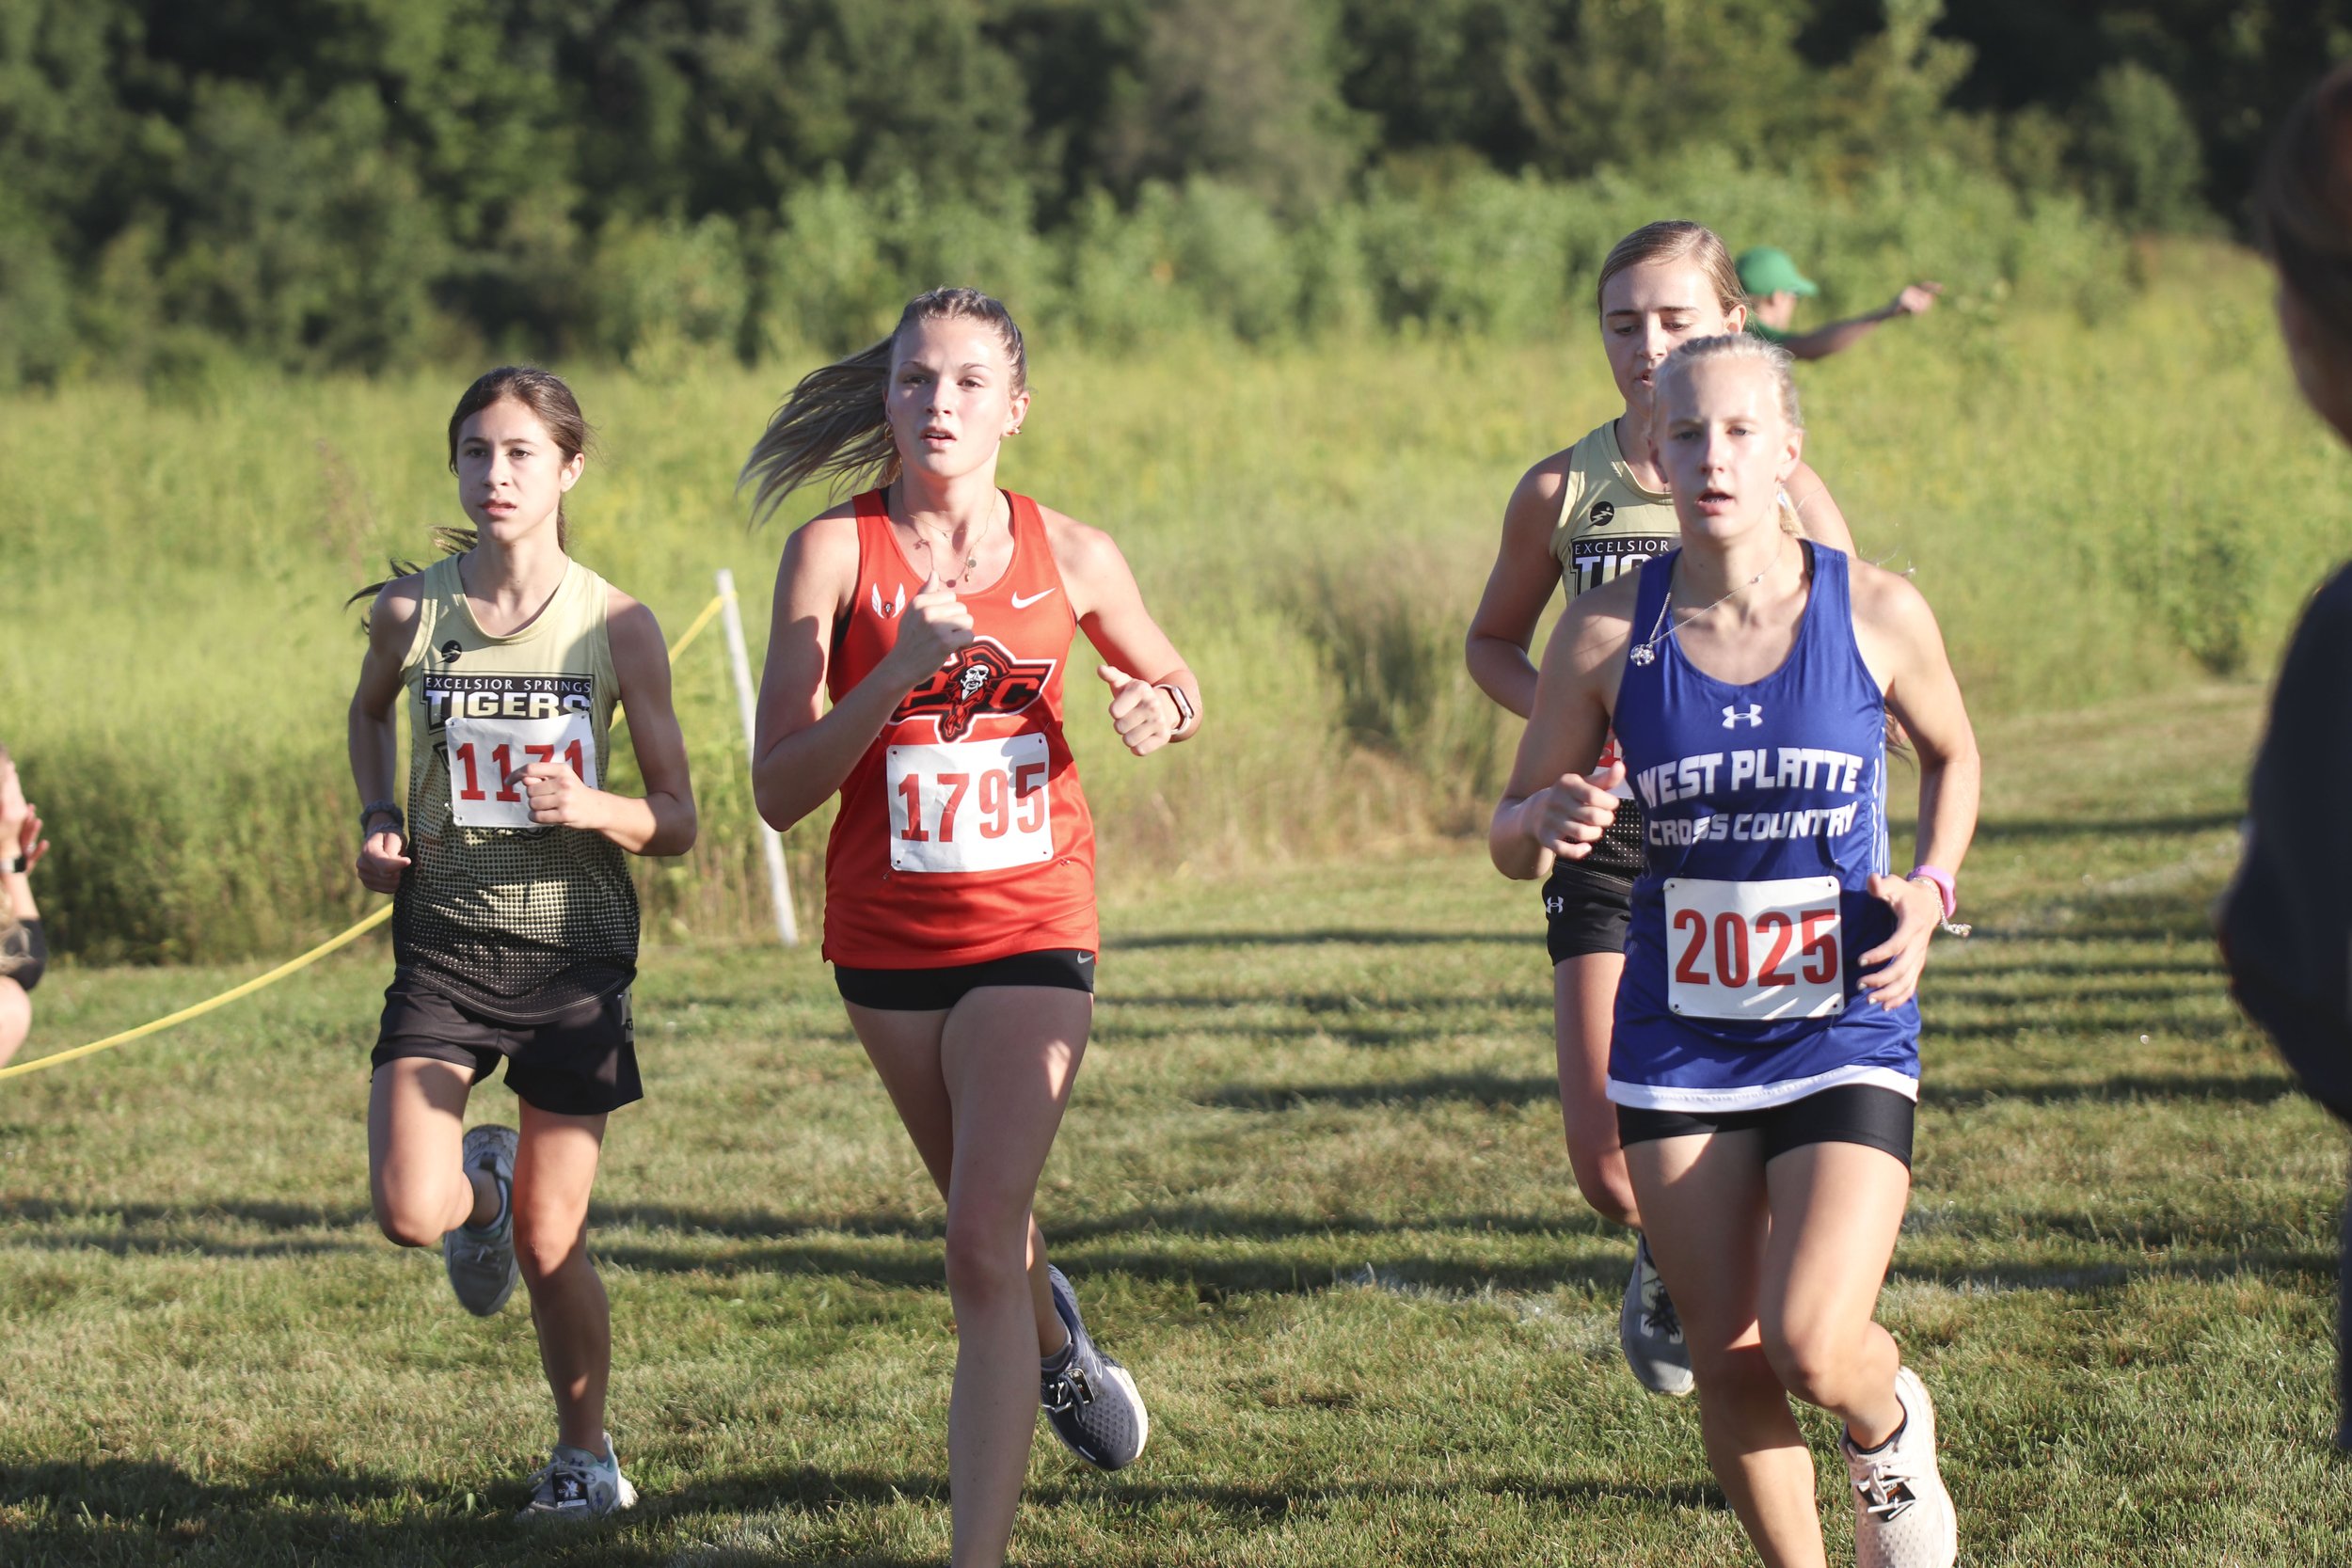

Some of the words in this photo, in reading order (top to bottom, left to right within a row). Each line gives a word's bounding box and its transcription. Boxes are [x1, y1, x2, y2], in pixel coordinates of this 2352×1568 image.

[1575, 540, 1669, 555] EXCELSIOR
[425, 677, 513, 690] EXCELSIOR
[524, 679, 591, 693] SPRINGS
[898, 761, 1046, 843] 1795
[1636, 752, 1724, 809] WEST
[1730, 747, 1864, 794] PLATTE
[1649, 813, 1730, 847] CROSS
[1733, 800, 1858, 842] COUNTRY
[1673, 908, 1838, 989] 2025
